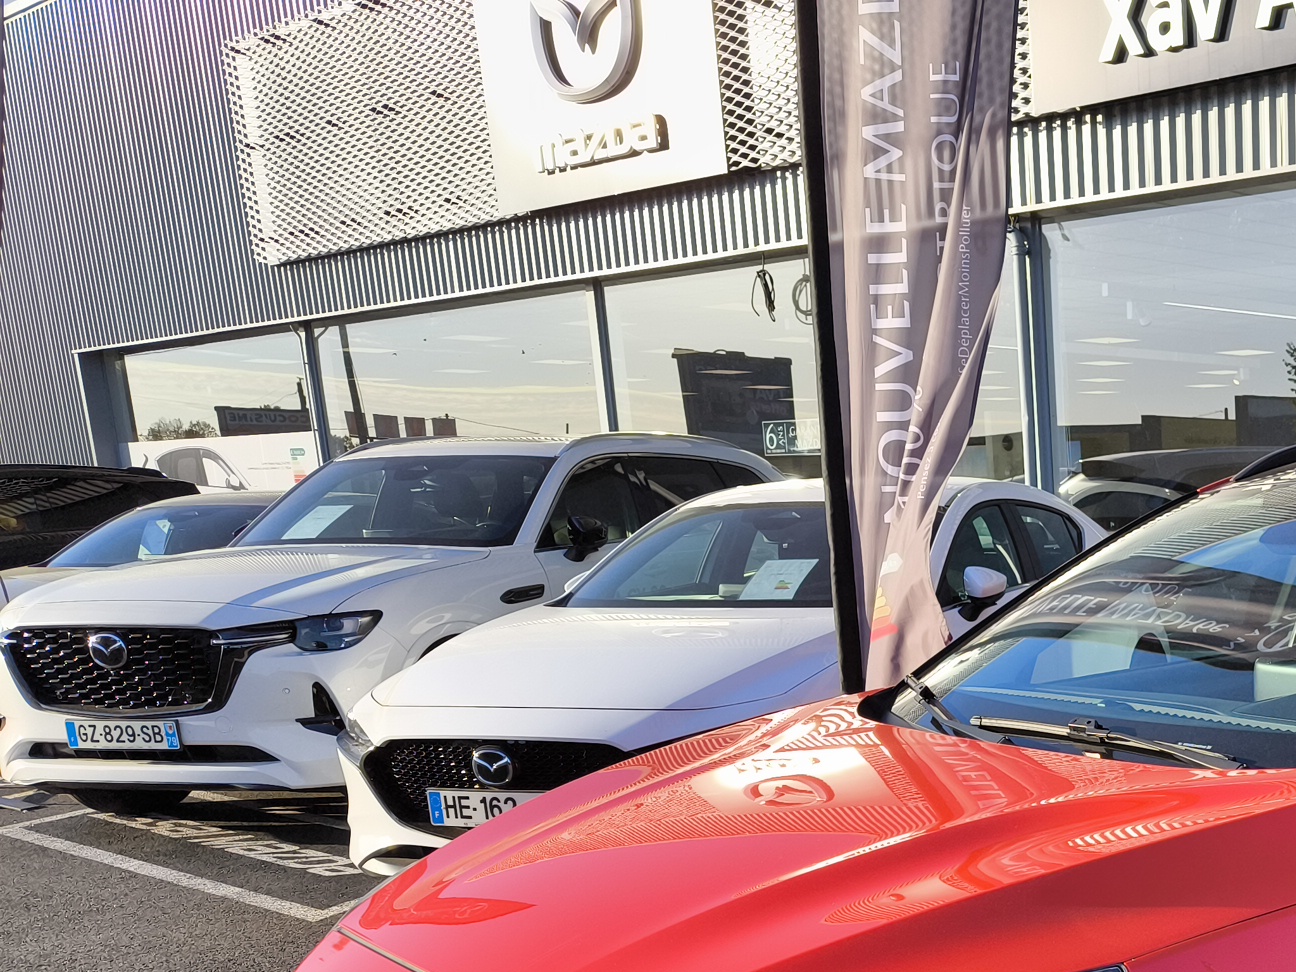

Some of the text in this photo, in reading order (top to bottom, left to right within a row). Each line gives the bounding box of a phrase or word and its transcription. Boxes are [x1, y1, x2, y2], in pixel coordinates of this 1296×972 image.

[957, 203, 974, 377] SeDéplacerMoinsPolluer
[765, 423, 778, 450] 6
[78, 724, 165, 744] GZ-829-SB
[167, 736, 179, 746] 79
[434, 811, 440, 819] F
